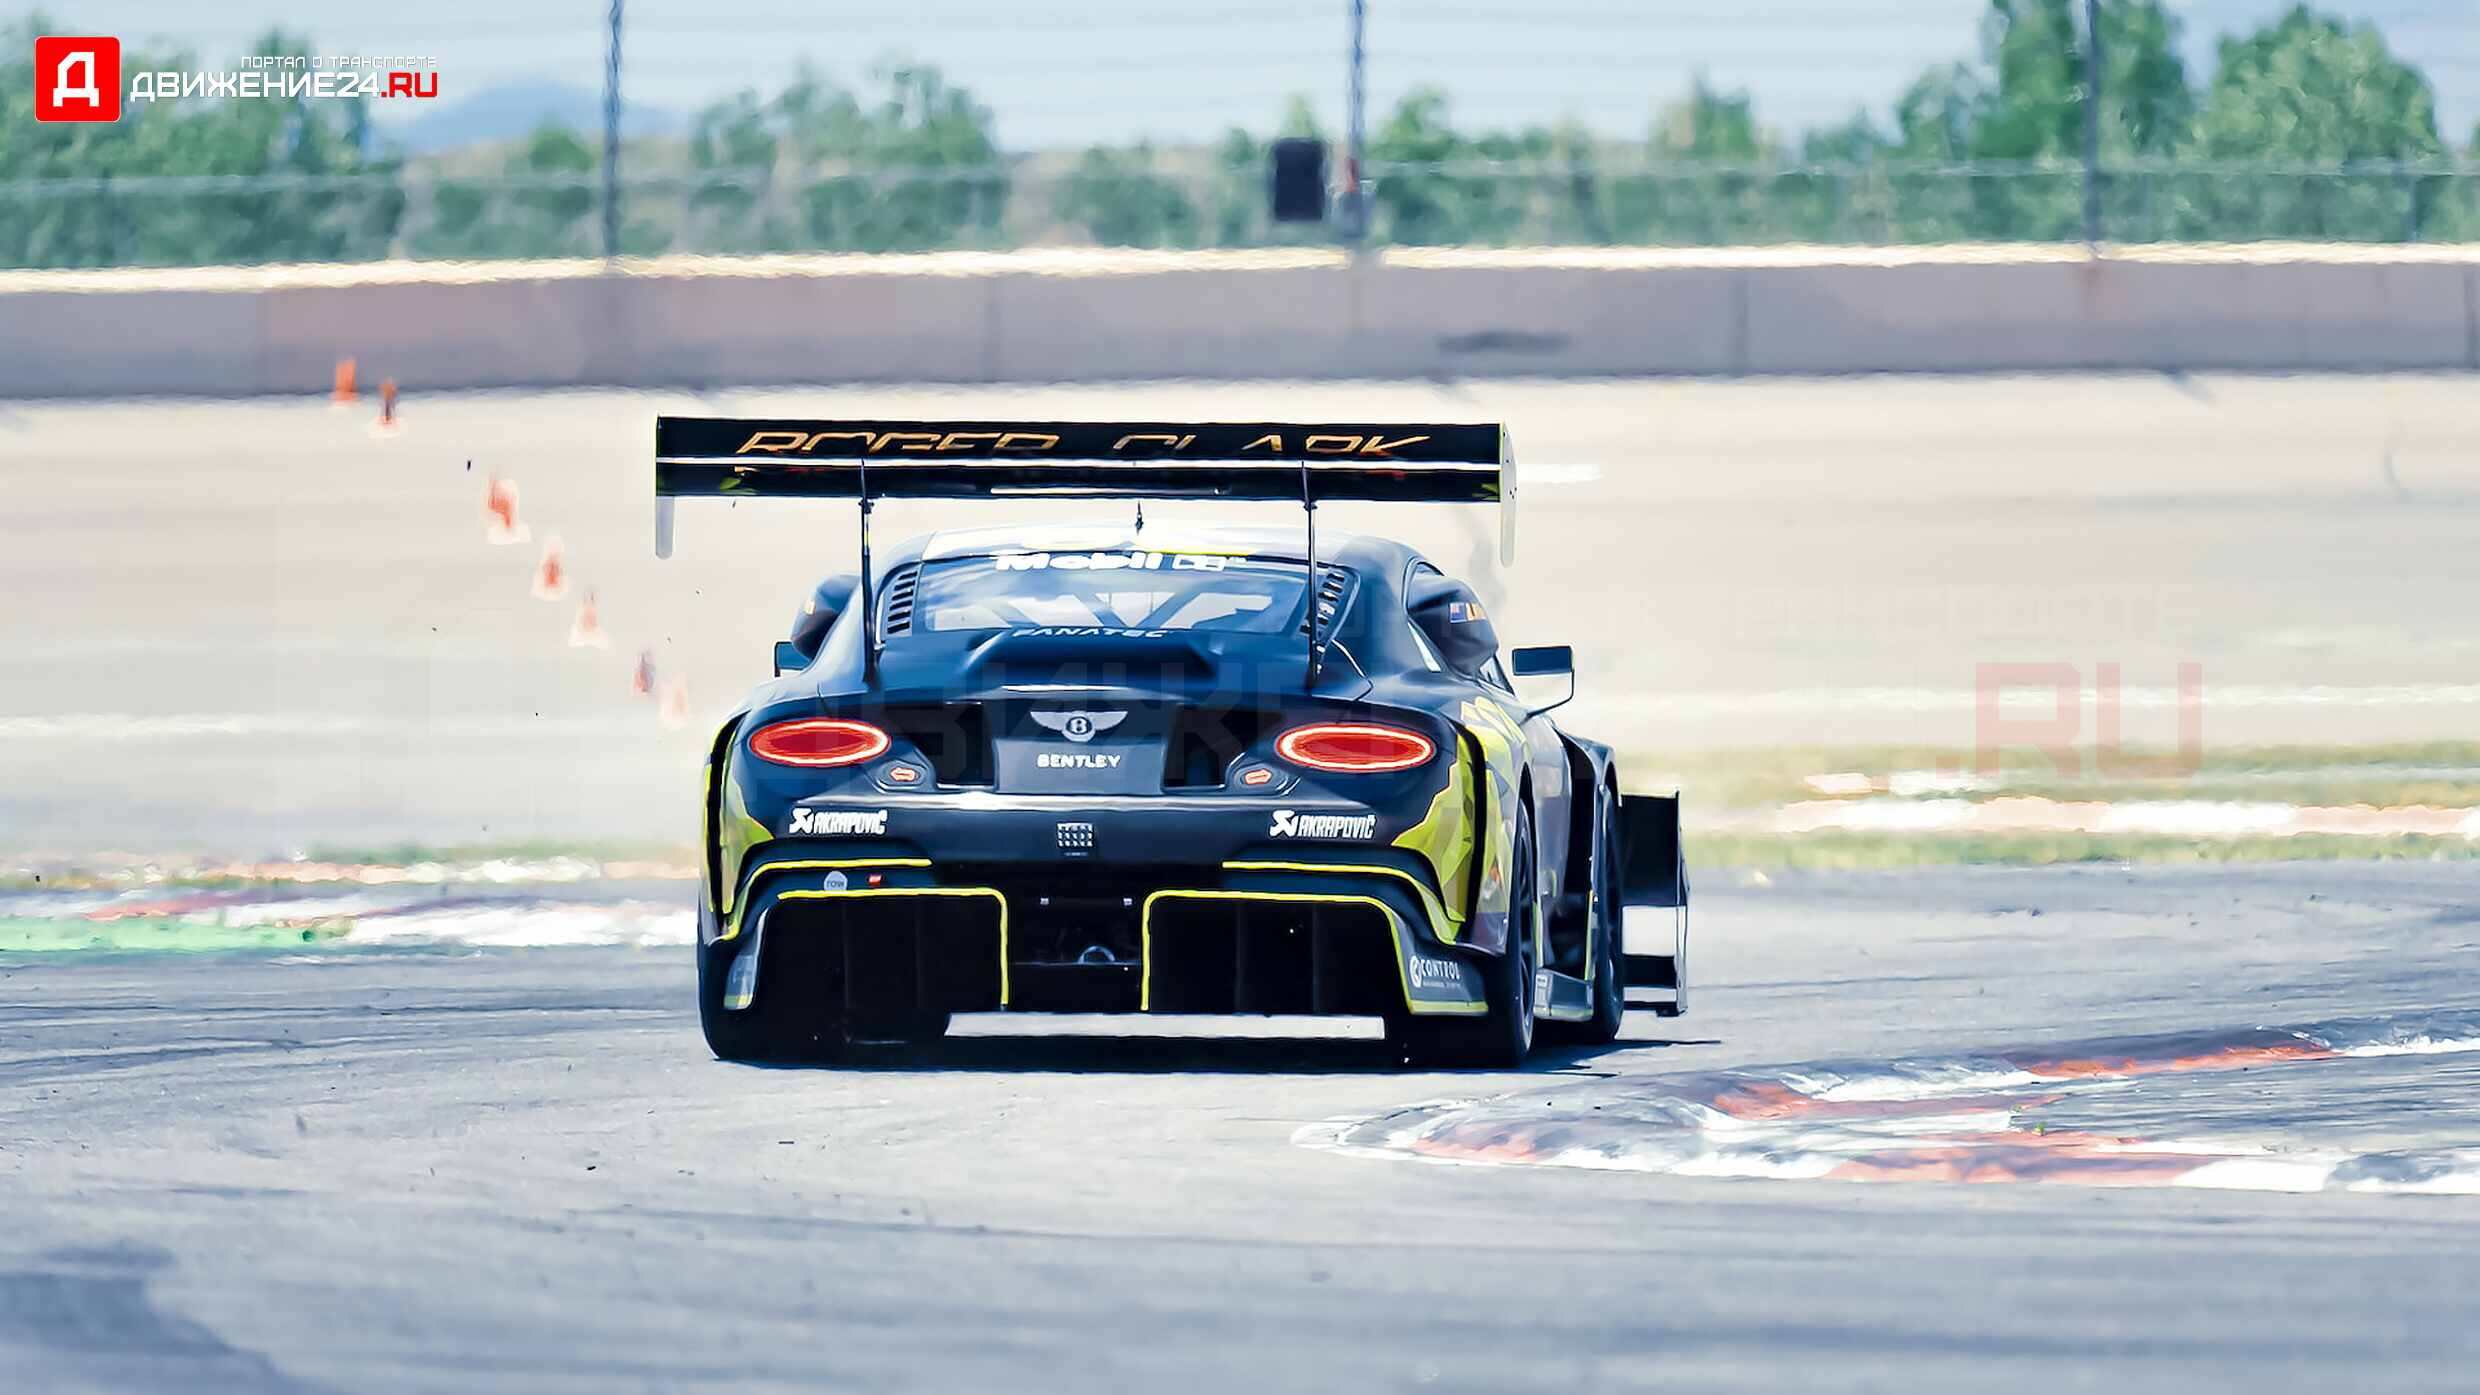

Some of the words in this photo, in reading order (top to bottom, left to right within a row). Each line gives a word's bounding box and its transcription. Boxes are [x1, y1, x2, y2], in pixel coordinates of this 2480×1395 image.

[996, 551, 1164, 571] Mobil
[1012, 627, 1168, 638] FANATEC
[1036, 753, 1121, 769] BENTLEY
